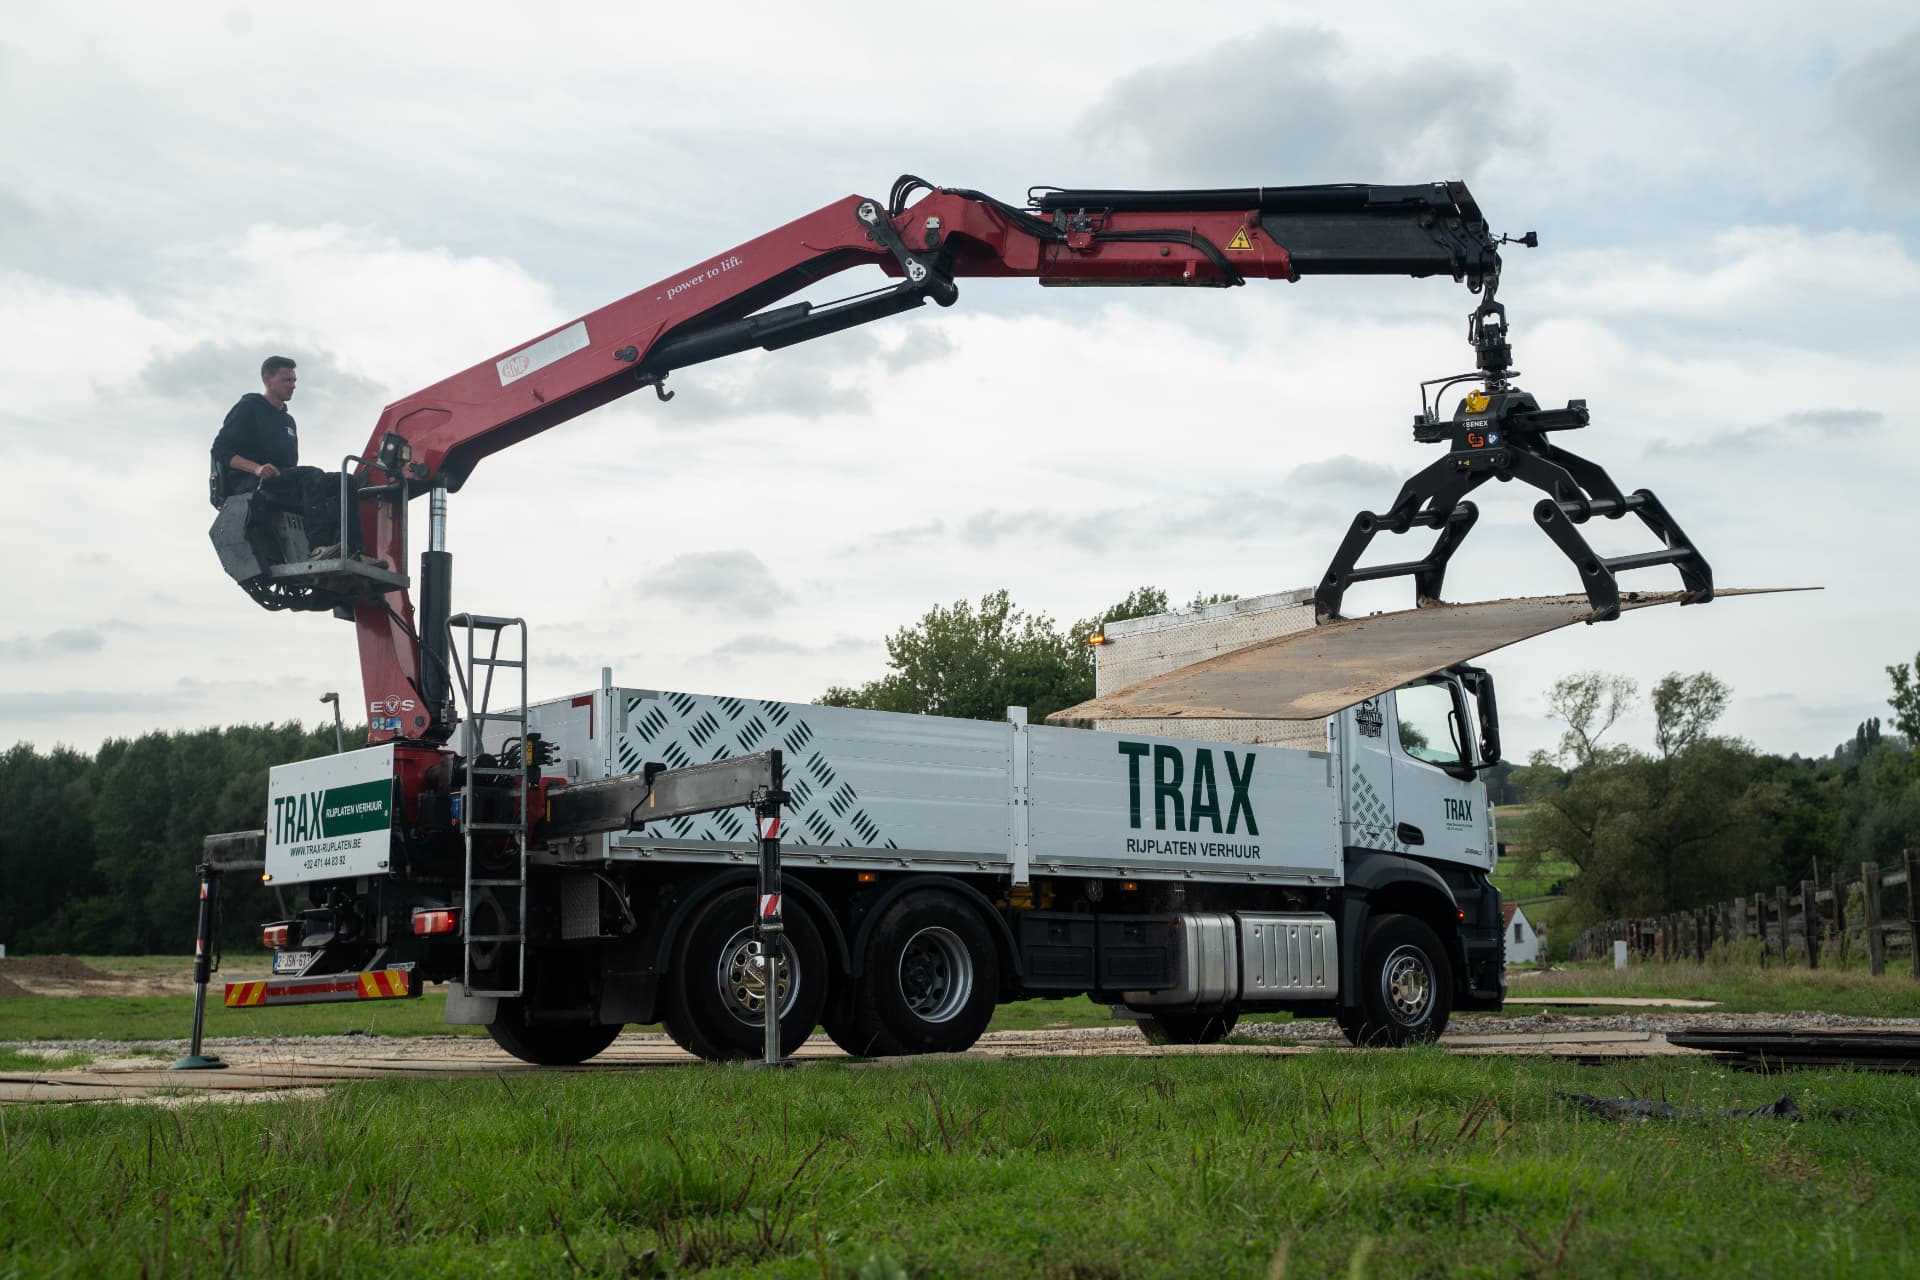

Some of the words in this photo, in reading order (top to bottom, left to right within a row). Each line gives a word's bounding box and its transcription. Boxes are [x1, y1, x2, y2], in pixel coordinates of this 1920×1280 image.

[667, 274, 704, 300] power
[707, 268, 719, 279] to
[721, 256, 743, 272] lift.
[1466, 420, 1488, 428] SENEX
[1118, 741, 1259, 836] TRAX
[274, 790, 323, 845] TRAX
[326, 804, 355, 818] RIJPLATEN
[356, 801, 383, 813] VERHUUR
[1443, 798, 1472, 821] TRAX
[290, 838, 361, 856] WWW.TRAX-RIJPLATEN.BE
[1127, 838, 1197, 856] RIJPLATEN
[1200, 842, 1260, 859] VERHUUR
[314, 858, 322, 868] 471
[324, 857, 331, 866] 44
